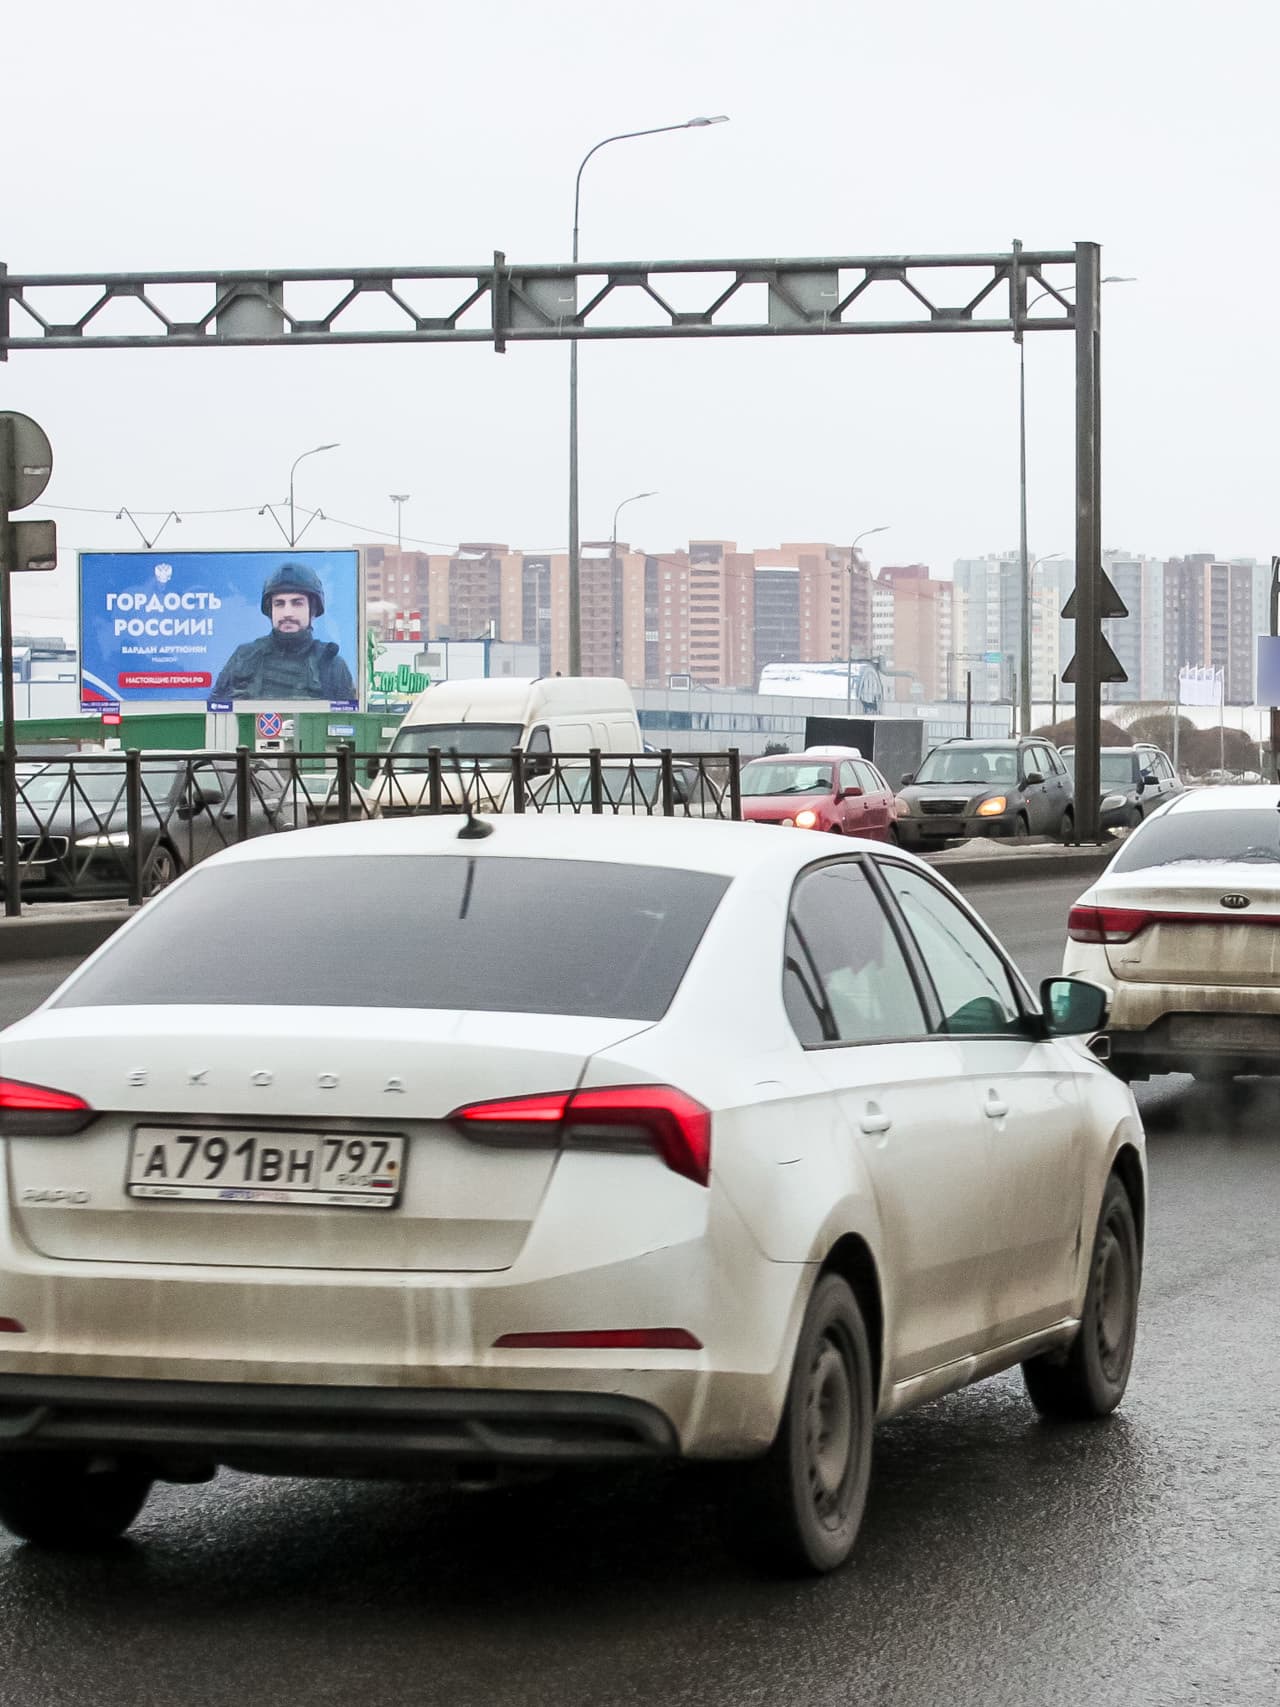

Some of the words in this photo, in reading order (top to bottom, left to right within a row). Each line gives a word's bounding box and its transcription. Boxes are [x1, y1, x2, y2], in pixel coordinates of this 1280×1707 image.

[106, 592, 222, 613] ГОРДОСТЬ
[114, 618, 214, 637] РОССИИ!
[1224, 896, 1245, 905] KIA
[322, 1138, 391, 1175] 797
